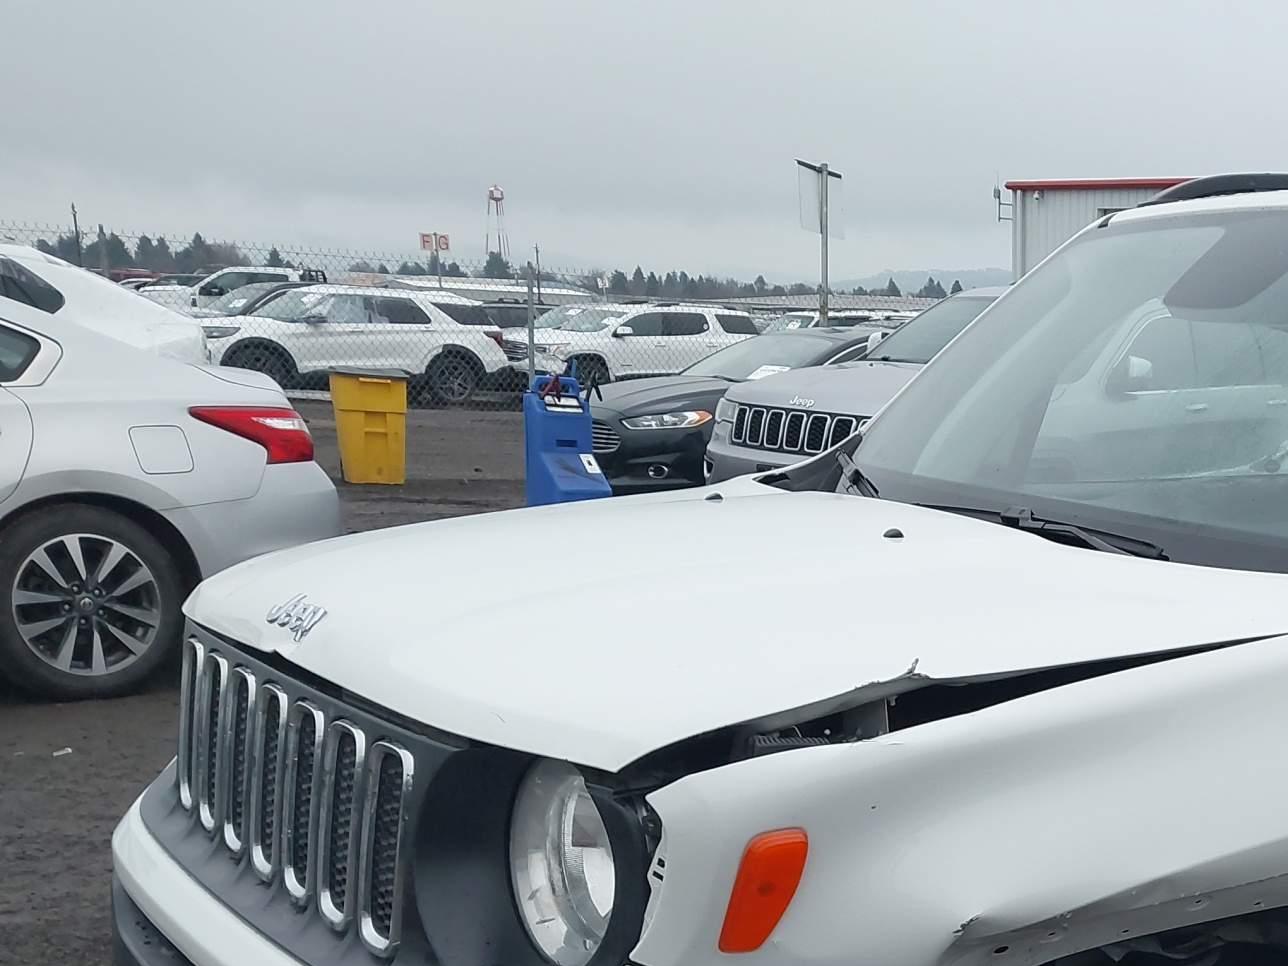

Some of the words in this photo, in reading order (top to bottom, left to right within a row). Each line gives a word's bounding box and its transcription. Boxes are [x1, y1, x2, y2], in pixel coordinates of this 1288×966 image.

[422, 234, 430, 248] F
[789, 395, 815, 408] Jeep
[265, 592, 328, 642] Jeep
